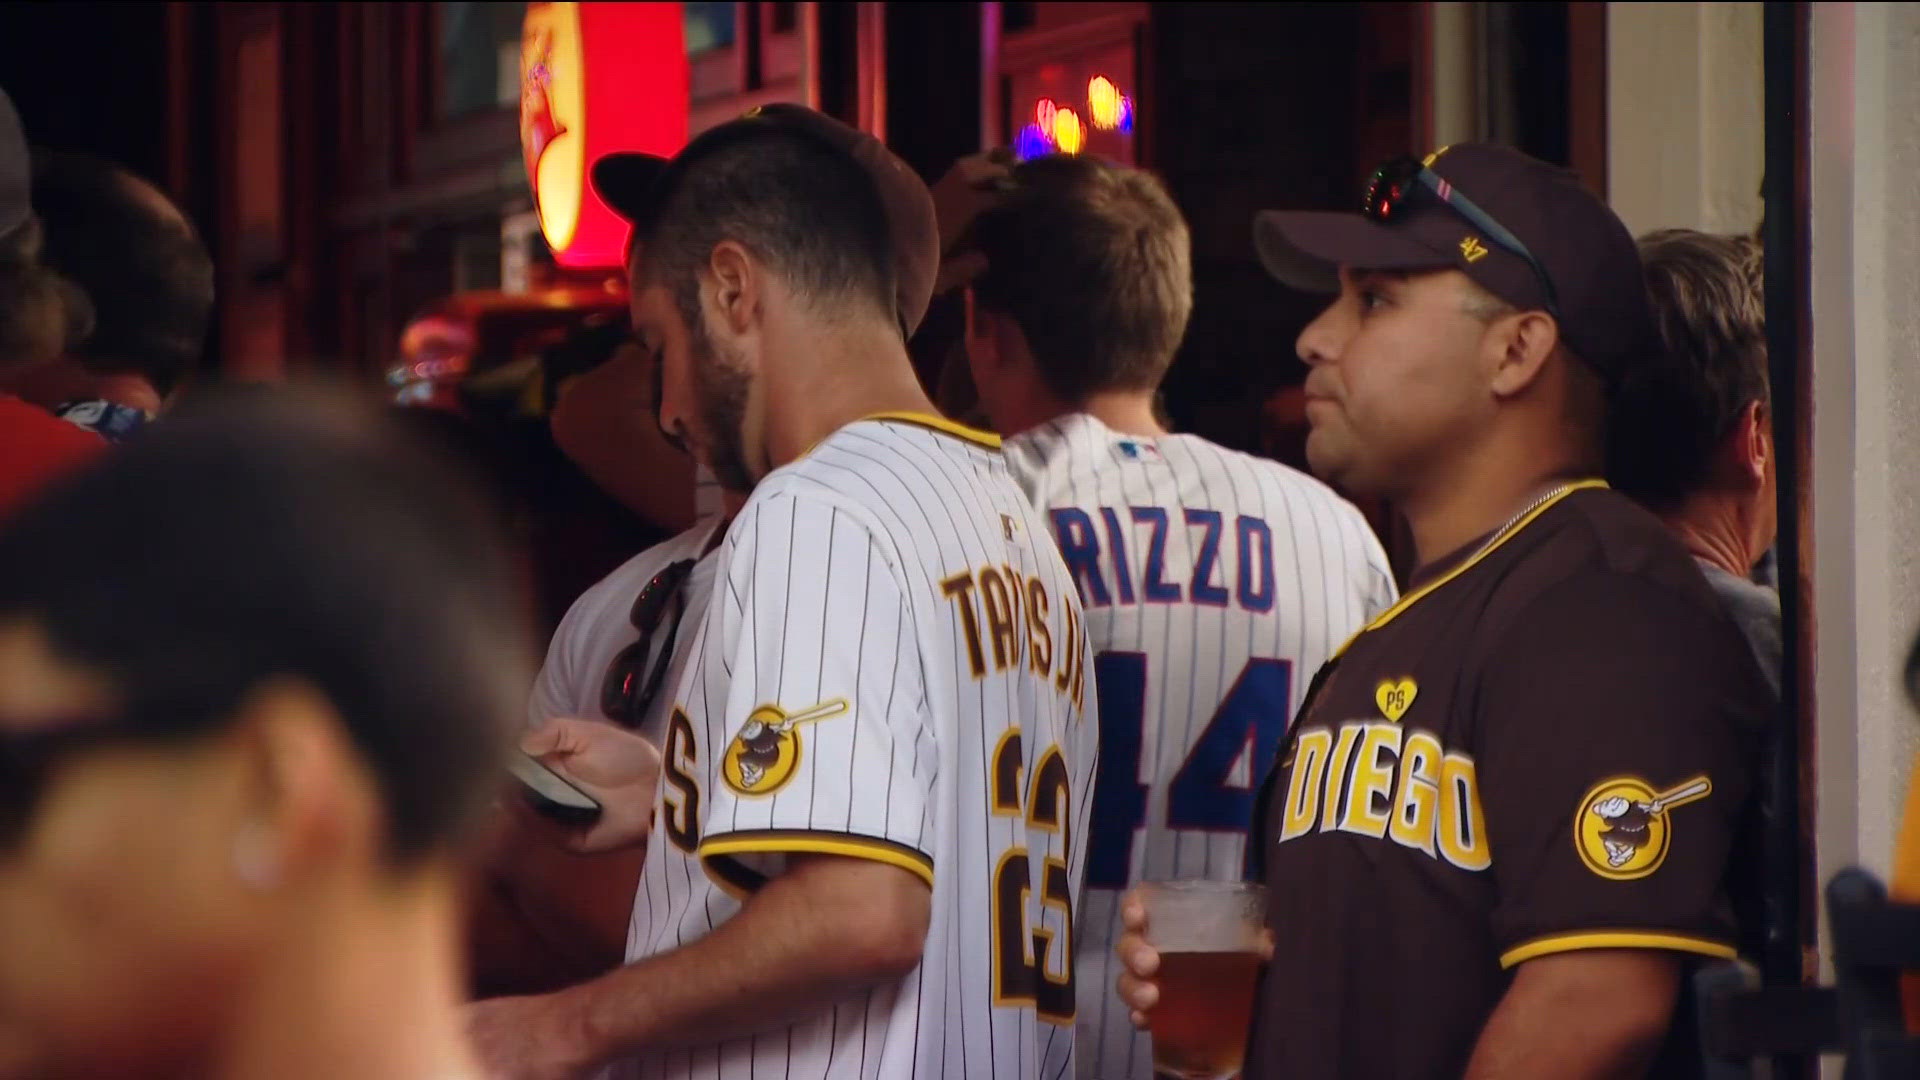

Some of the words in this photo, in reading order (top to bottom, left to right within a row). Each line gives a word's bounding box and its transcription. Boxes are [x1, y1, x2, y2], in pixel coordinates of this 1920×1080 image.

[1049, 506, 1275, 615] RIZZO
[1386, 690, 1405, 712] PS
[1279, 722, 1492, 872] DIEGO
